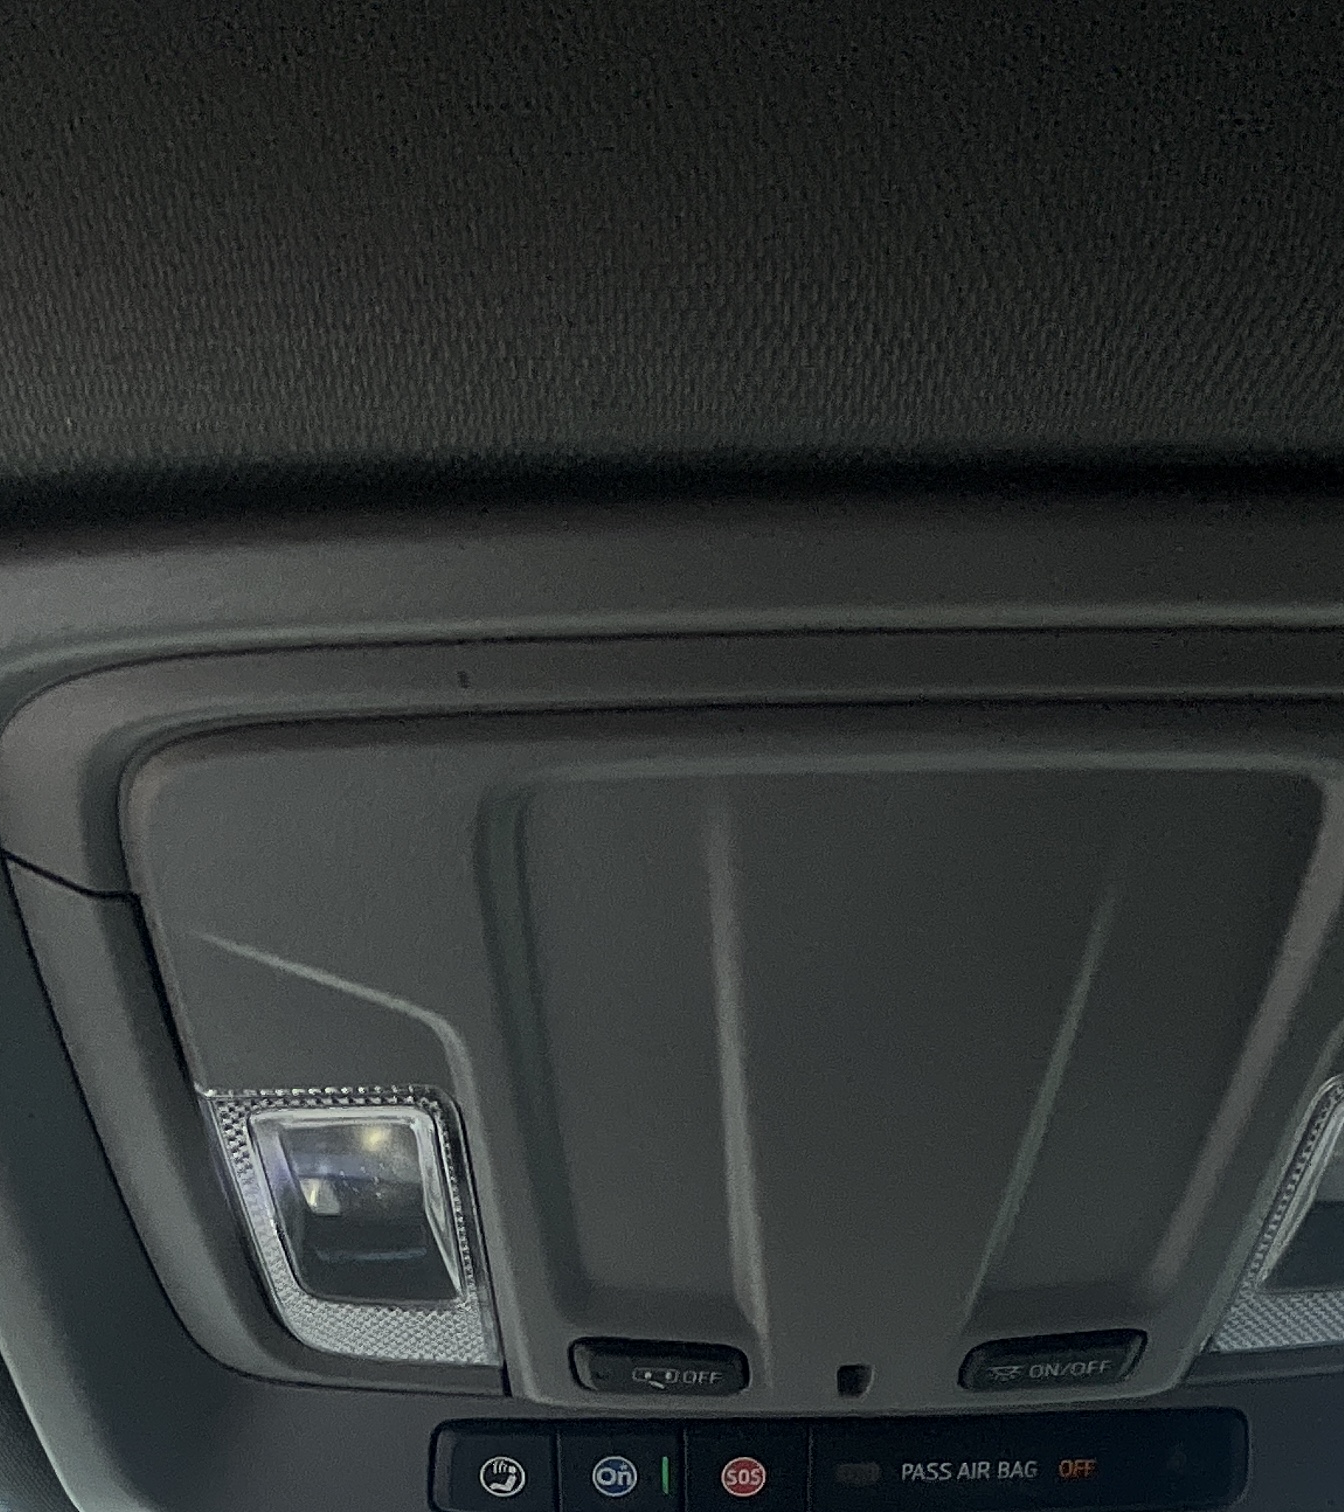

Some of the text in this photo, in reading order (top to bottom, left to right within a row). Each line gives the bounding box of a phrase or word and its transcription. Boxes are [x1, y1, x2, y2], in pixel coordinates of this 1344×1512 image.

[683, 1370, 723, 1384] OFF
[1029, 1360, 1112, 1379] ON/OFF
[596, 1463, 632, 1486] On
[726, 1468, 762, 1486] SOS
[901, 1459, 1096, 1481] PASS AIR BAG OFF
